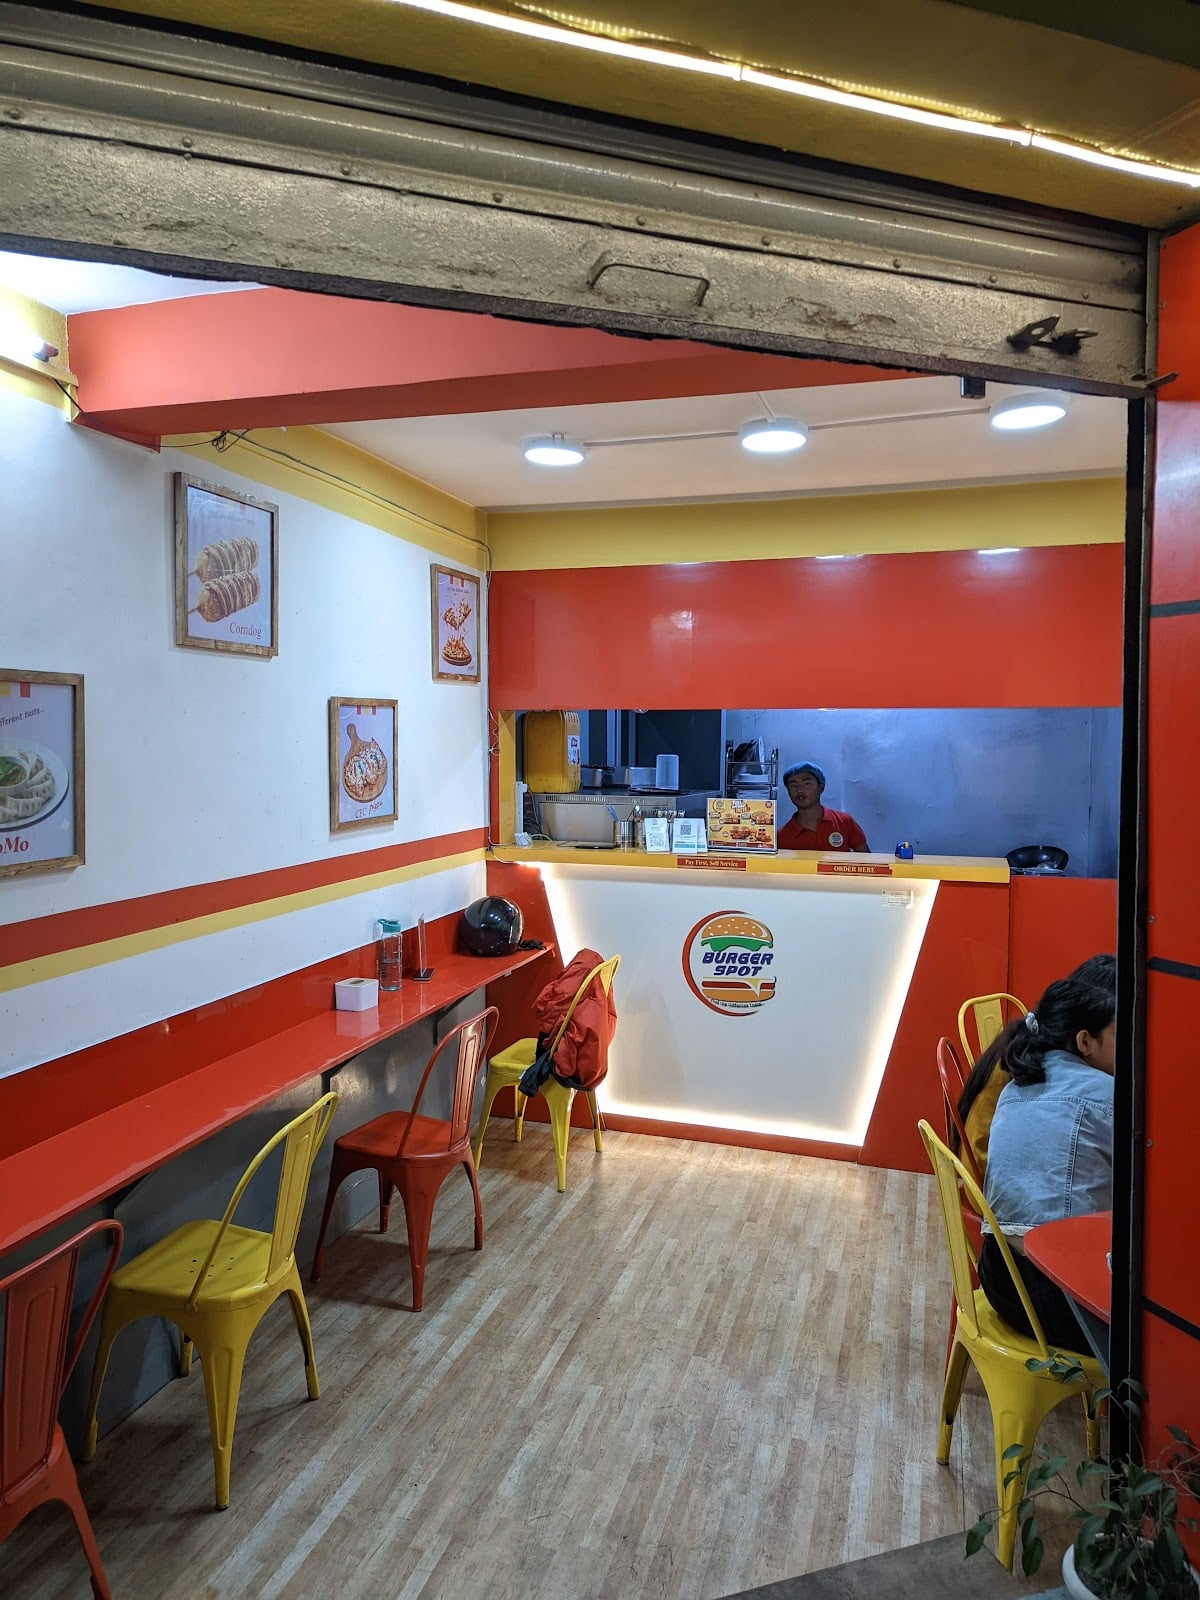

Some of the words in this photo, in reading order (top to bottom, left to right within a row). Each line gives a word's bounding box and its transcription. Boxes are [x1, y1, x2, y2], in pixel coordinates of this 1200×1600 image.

[229, 621, 262, 640] Corndog
[685, 859, 694, 867] Pay
[833, 865, 857, 873] ORDER
[702, 952, 774, 965] BURGER
[713, 965, 763, 976] SPOT
